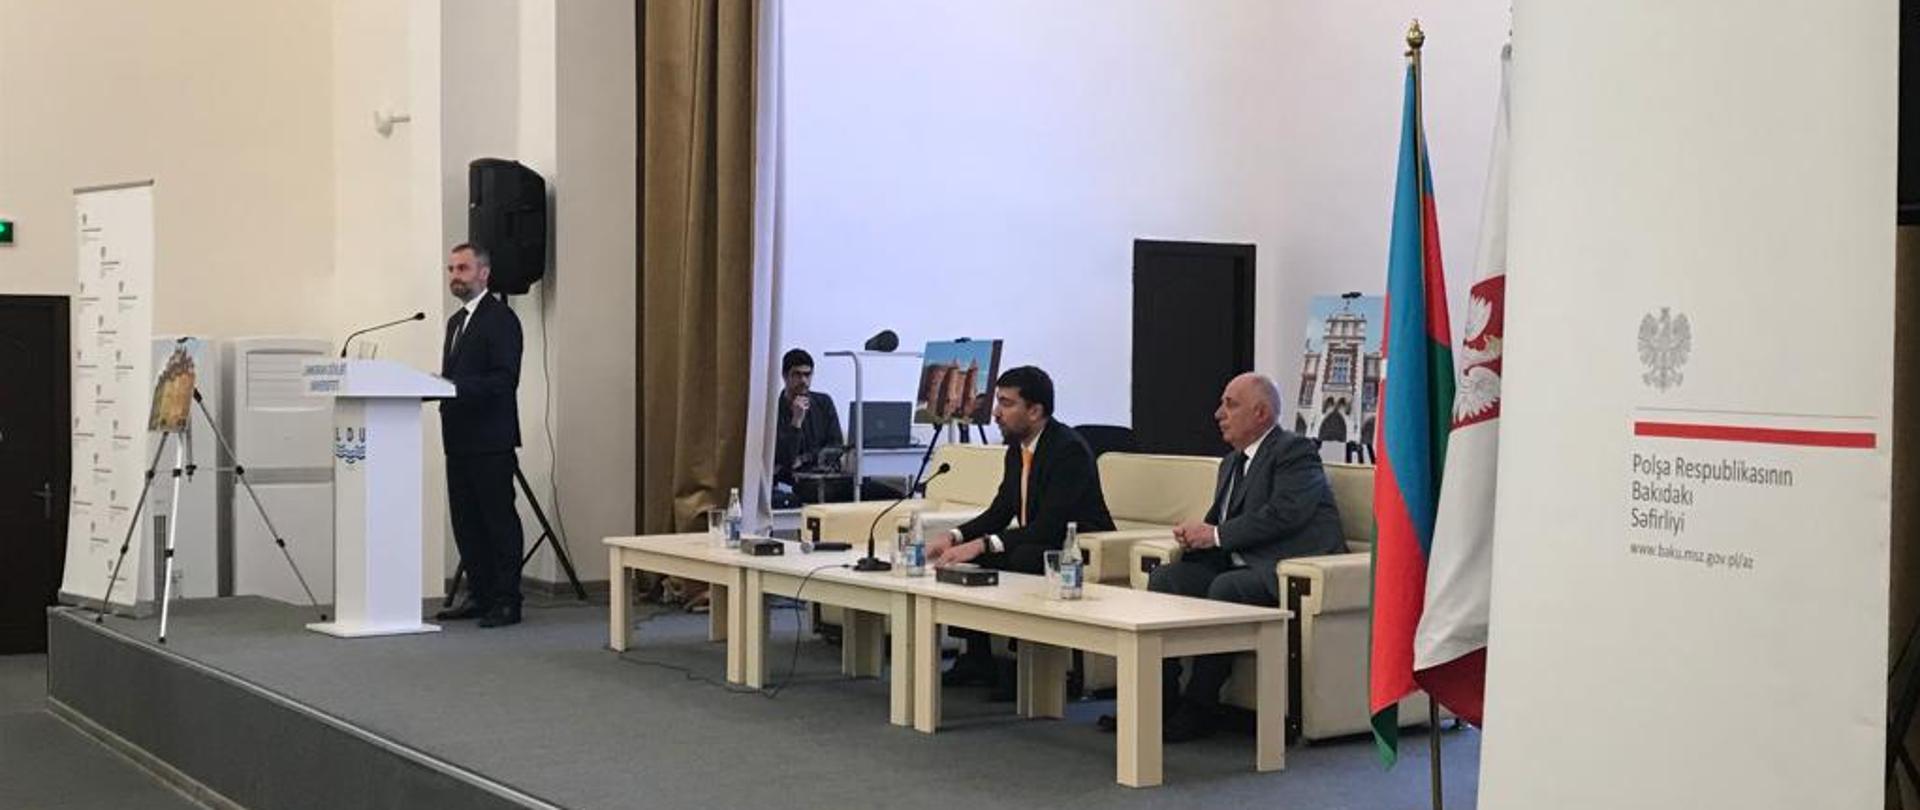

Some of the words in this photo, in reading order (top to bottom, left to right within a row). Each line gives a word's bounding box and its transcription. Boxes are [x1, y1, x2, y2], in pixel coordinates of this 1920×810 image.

[1633, 454, 1671, 480] Polşa
[1675, 457, 1793, 486] Respublikasının
[1632, 480, 1693, 505] Bakıdakı
[1631, 507, 1685, 536] Səfirliyi
